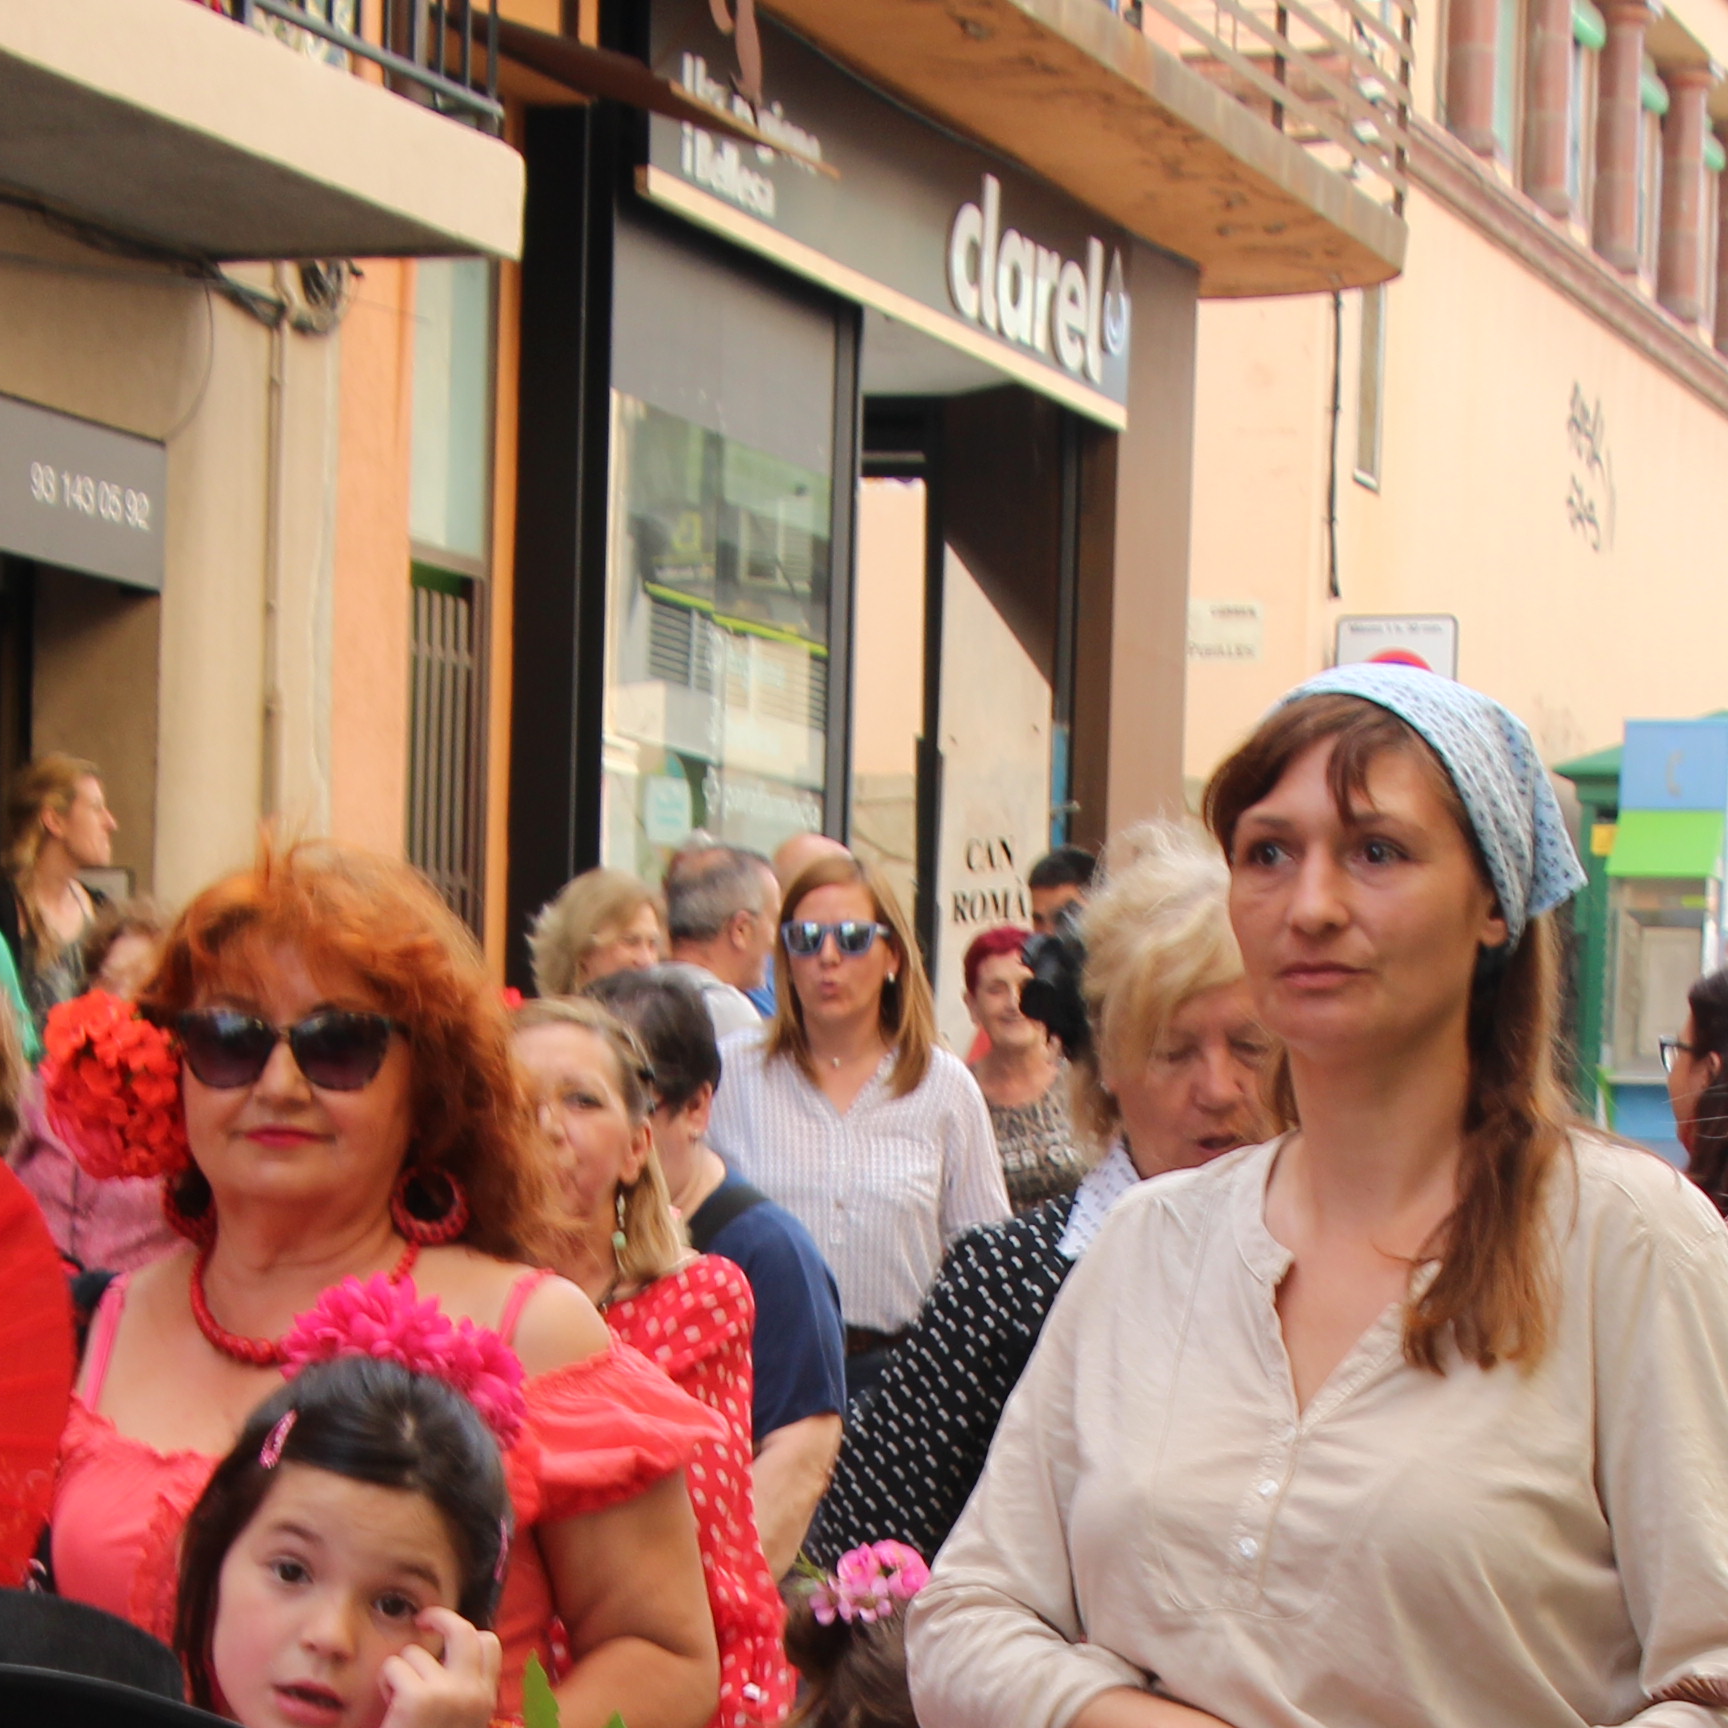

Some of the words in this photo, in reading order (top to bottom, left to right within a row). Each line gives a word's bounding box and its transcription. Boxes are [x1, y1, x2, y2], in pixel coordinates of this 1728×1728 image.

[695, 127, 776, 219] Bellesa
[948, 172, 1104, 386] clarel
[30, 461, 57, 504] 93
[62, 469, 96, 516] 143
[98, 480, 123, 523] 05
[124, 487, 151, 531] 92
[964, 836, 1015, 873] CAN
[951, 874, 1029, 923] ROMÀ
